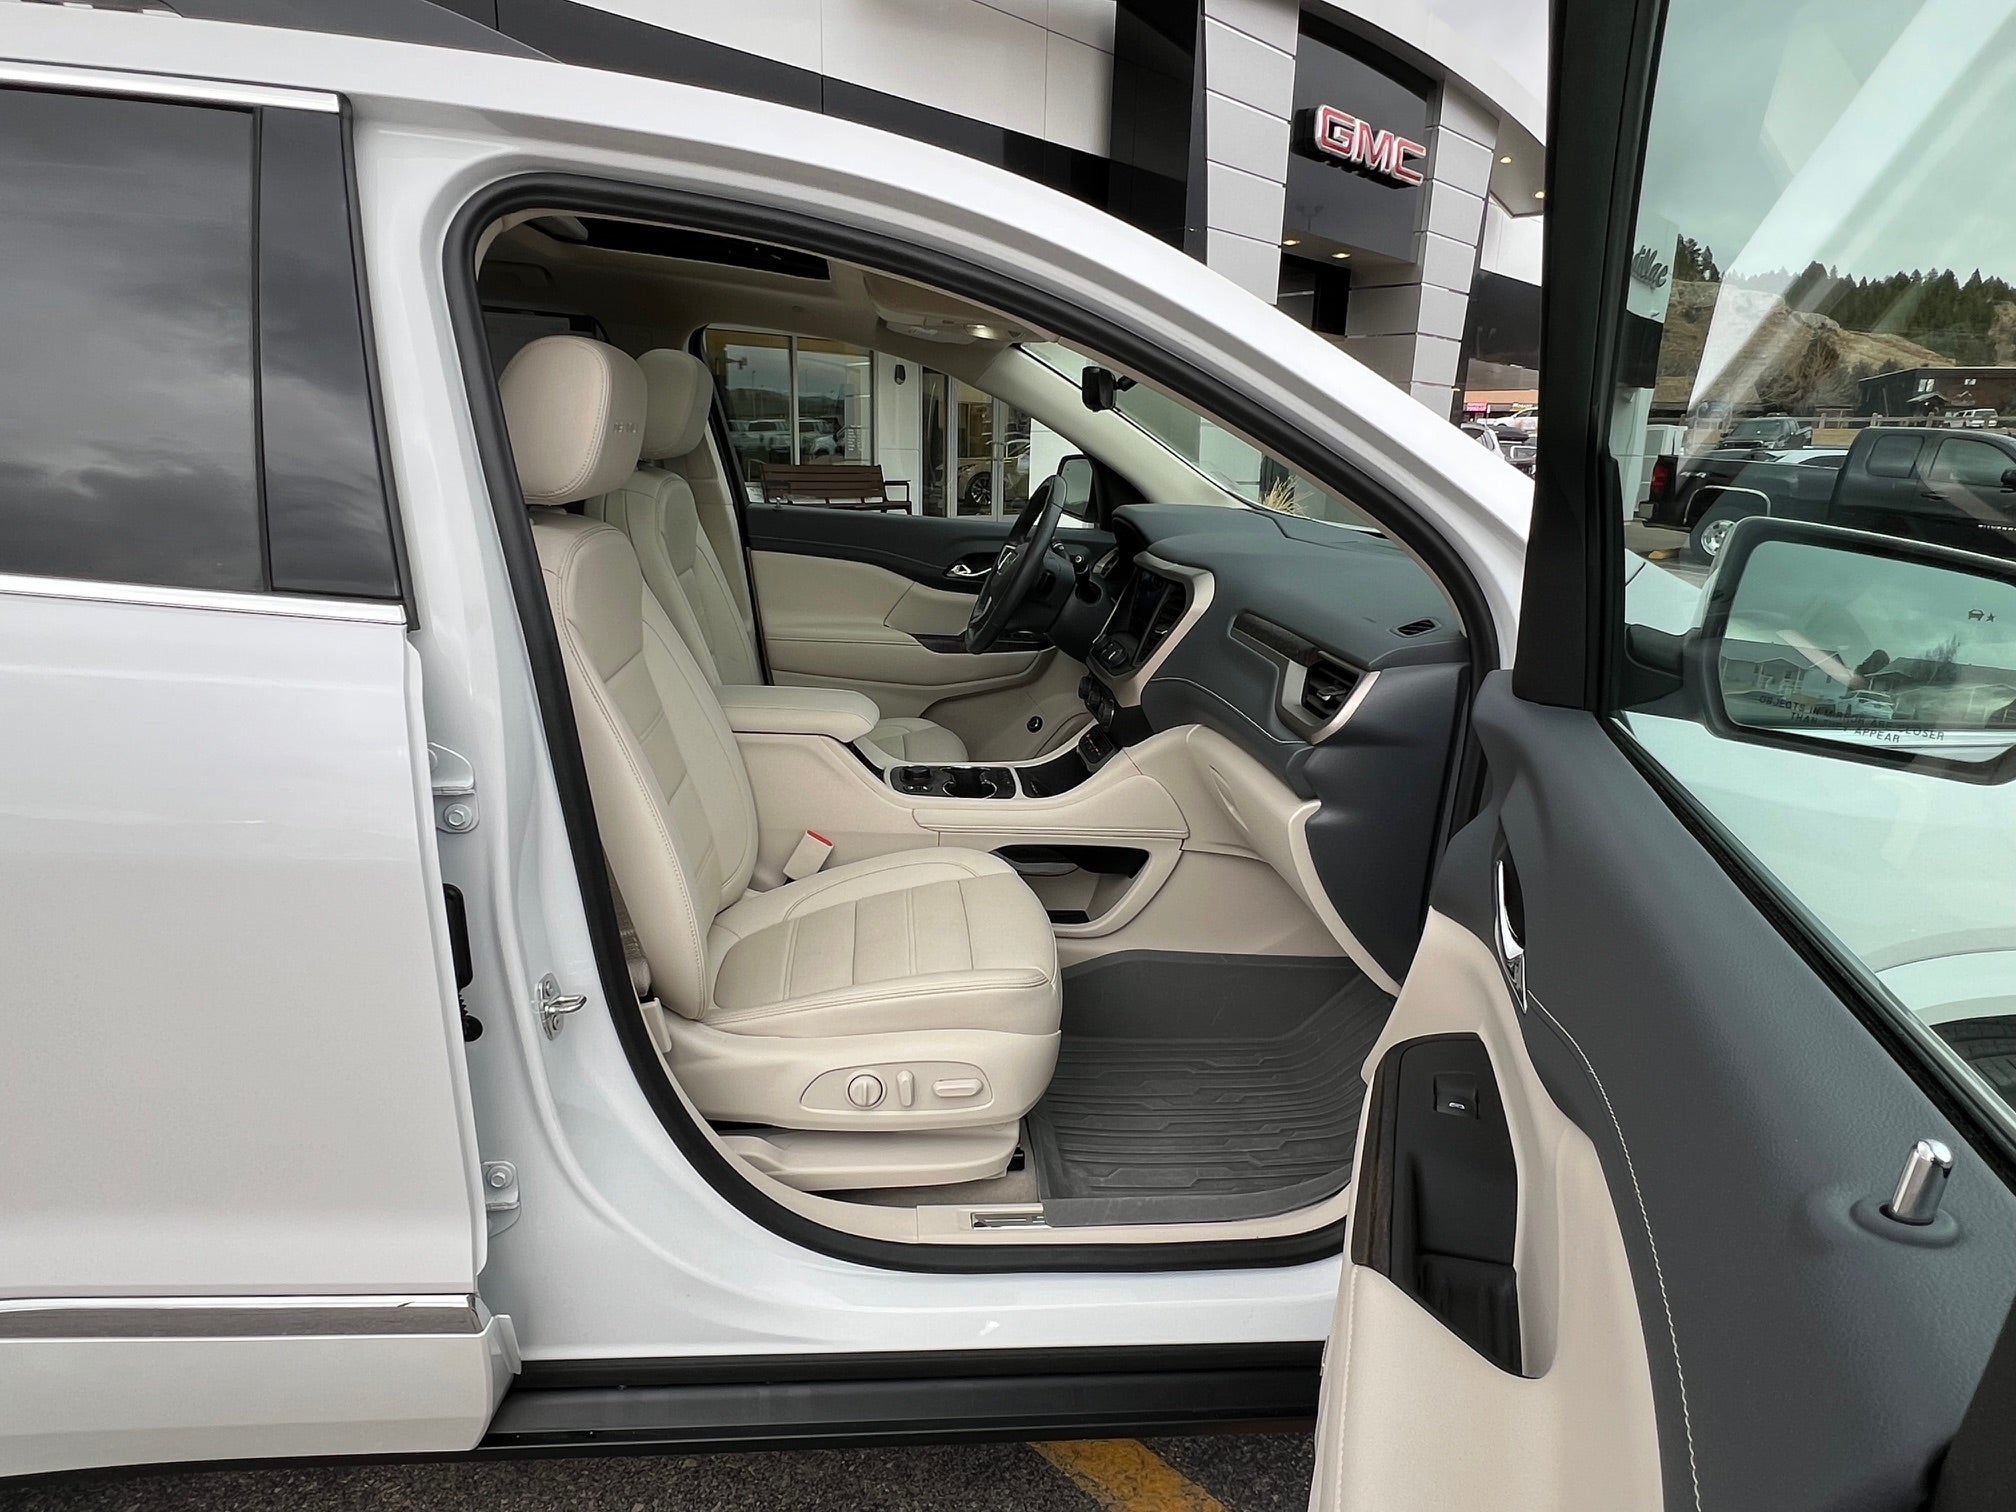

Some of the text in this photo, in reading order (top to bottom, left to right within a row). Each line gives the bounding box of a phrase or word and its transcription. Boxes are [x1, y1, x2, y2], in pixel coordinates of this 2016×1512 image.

[1315, 104, 1427, 187] GMC
[1759, 695, 1806, 712] OBJECTS
[1791, 712, 1818, 725] THAN
[1854, 728, 1900, 743] APPEAR
